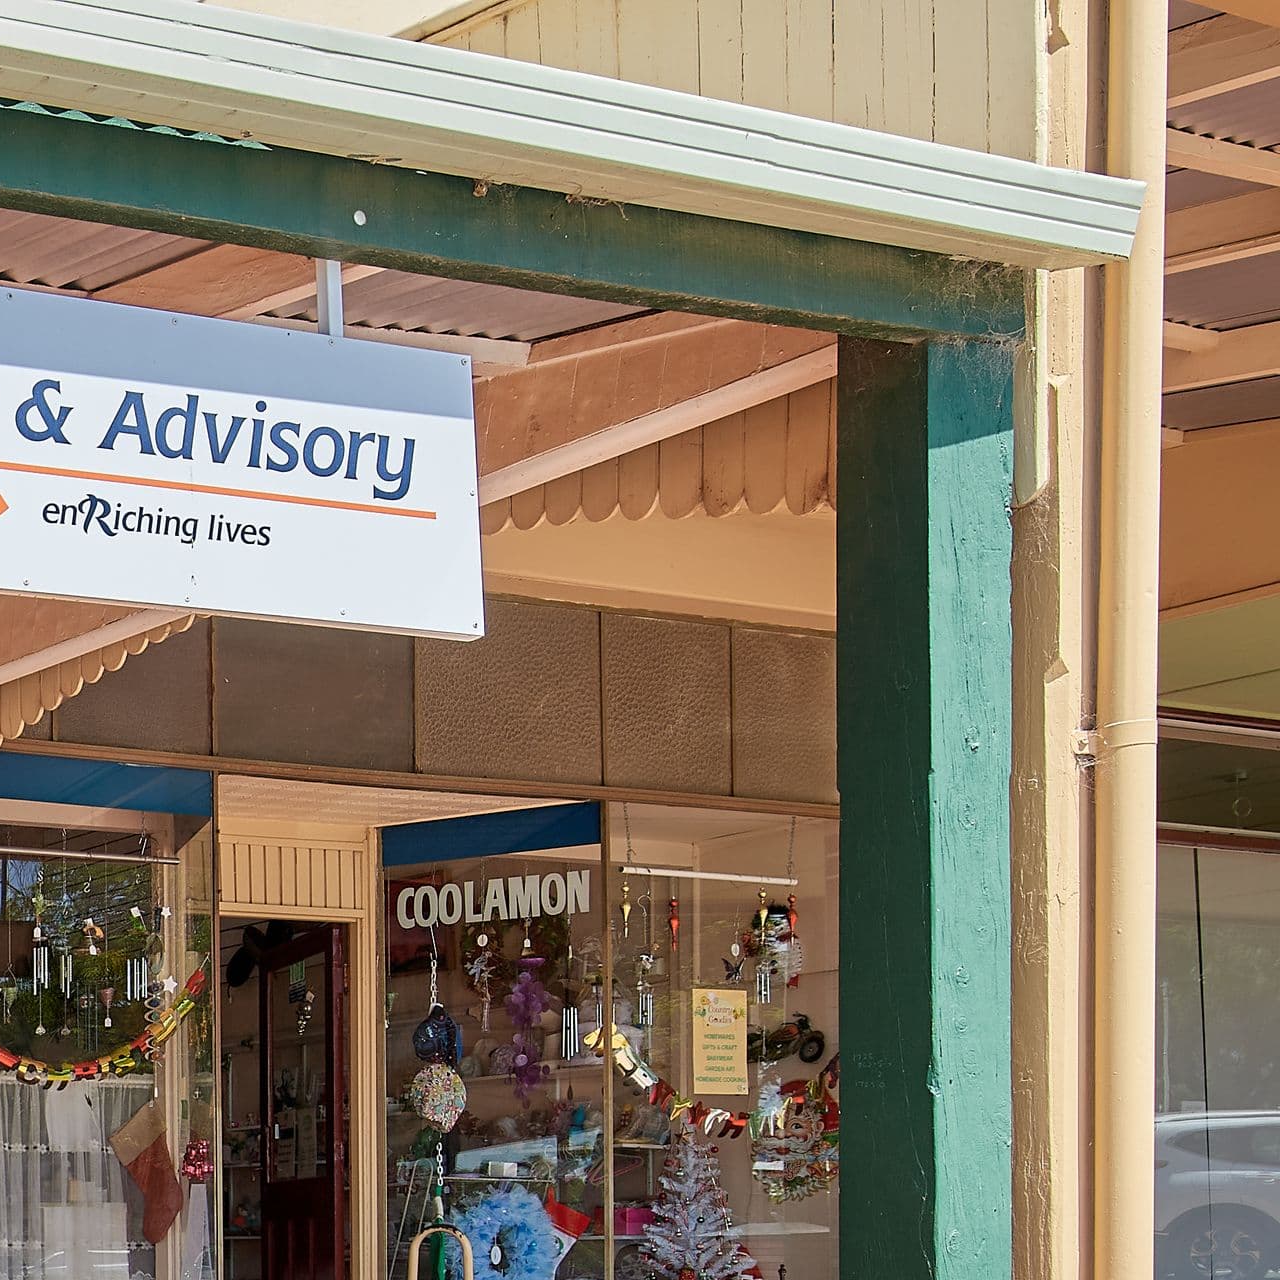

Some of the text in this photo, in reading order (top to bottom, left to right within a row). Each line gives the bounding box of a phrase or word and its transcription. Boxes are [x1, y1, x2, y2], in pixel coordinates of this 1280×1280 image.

[15, 379, 74, 445] &
[97, 391, 416, 500] Advisory
[42, 494, 199, 545] enRiching
[208, 515, 272, 547] lives
[397, 869, 591, 929] COOLAMON
